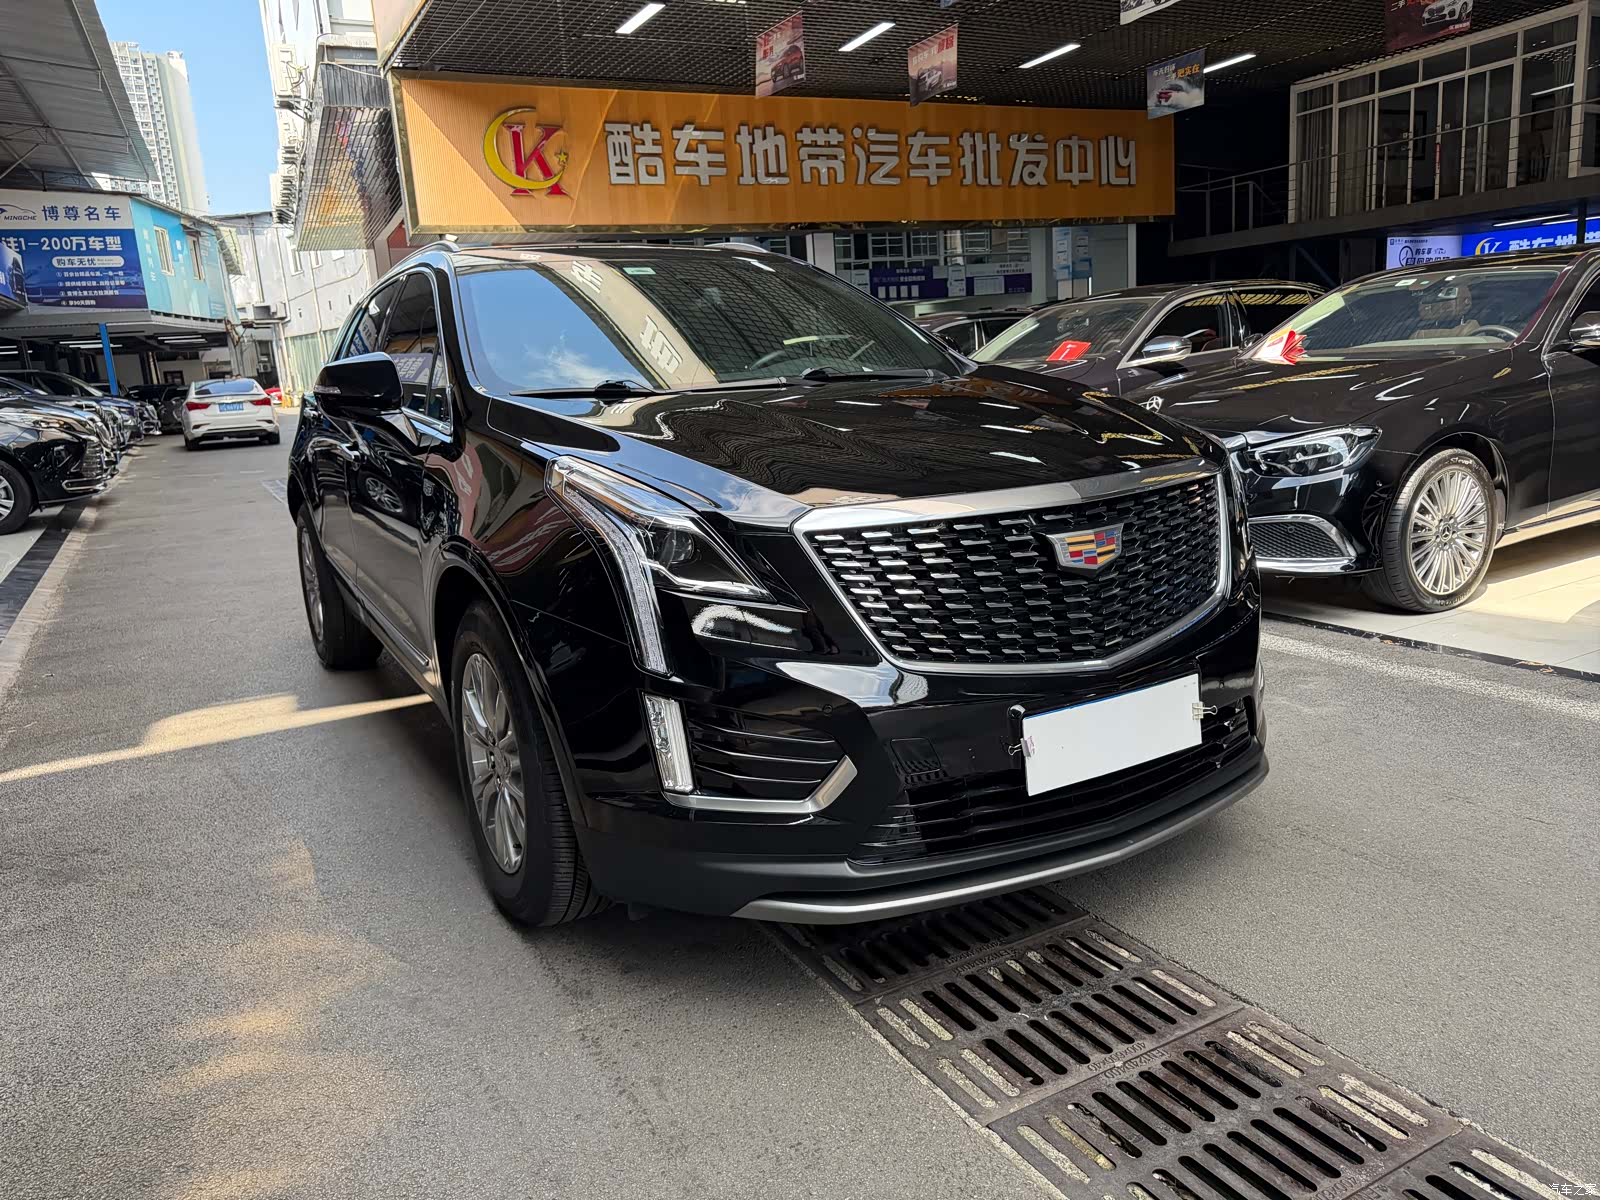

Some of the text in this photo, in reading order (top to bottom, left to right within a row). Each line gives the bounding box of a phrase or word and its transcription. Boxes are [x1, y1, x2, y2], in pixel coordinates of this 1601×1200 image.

[604, 120, 1138, 187] 酷车地带汽车批发中心
[42, 205, 121, 221] 博尊名车
[56, 258, 97, 266] 购车无忧
